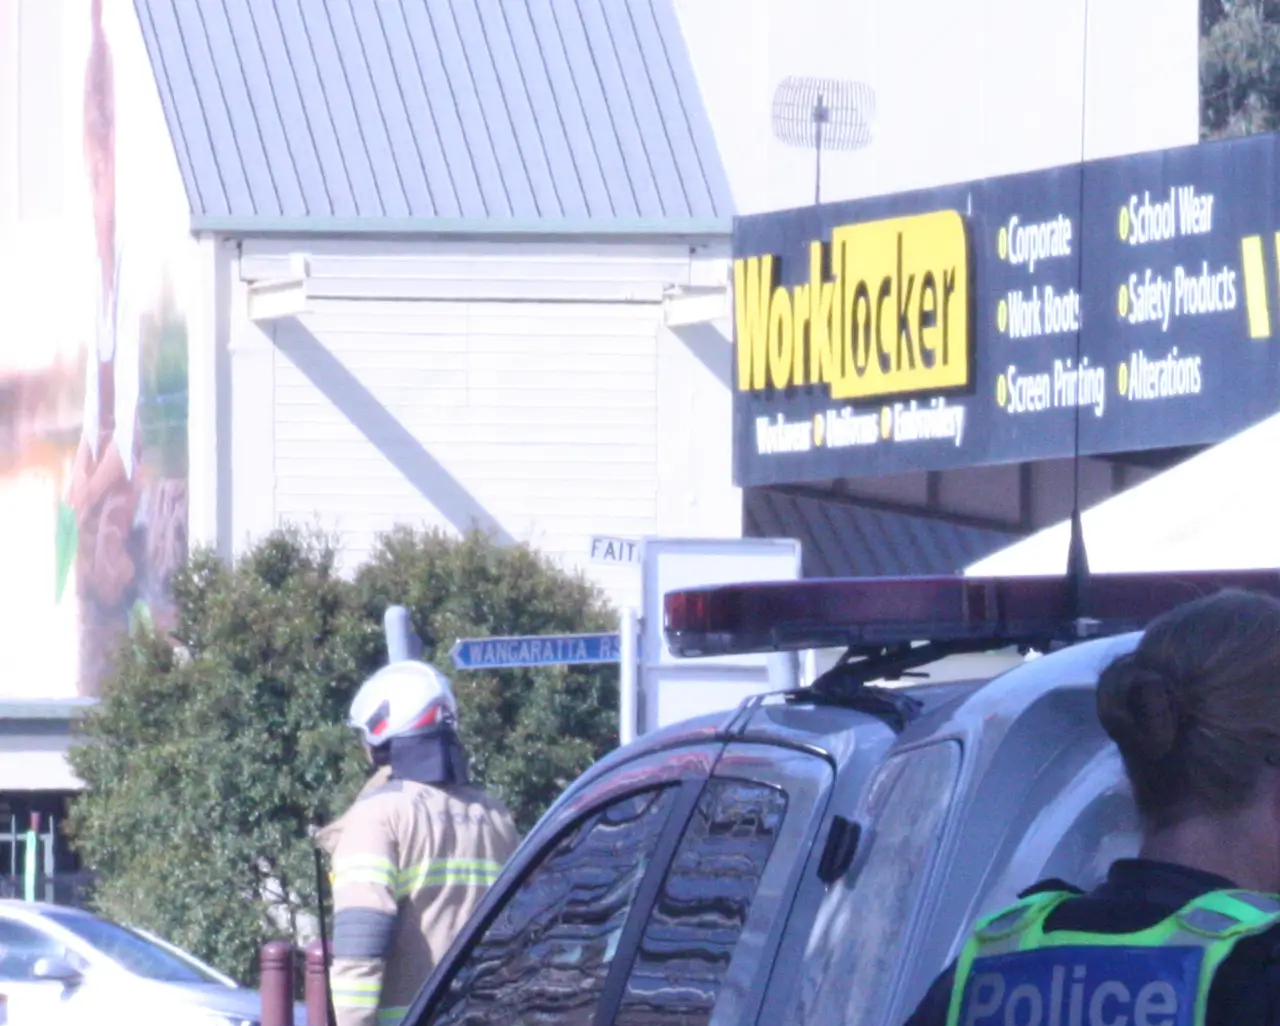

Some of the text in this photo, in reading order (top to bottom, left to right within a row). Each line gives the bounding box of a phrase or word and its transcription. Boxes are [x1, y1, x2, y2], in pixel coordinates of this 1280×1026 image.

[1129, 184, 1214, 245] School Wear
[1008, 215, 1072, 273] Corporate
[1008, 285, 1083, 339] Work Boots
[1128, 260, 1237, 332] Safety Products
[1007, 356, 1105, 417] Screen Printing
[1128, 346, 1202, 401] Alterations
[591, 538, 639, 562] FAIT
[469, 639, 588, 664] WANGARATTA
